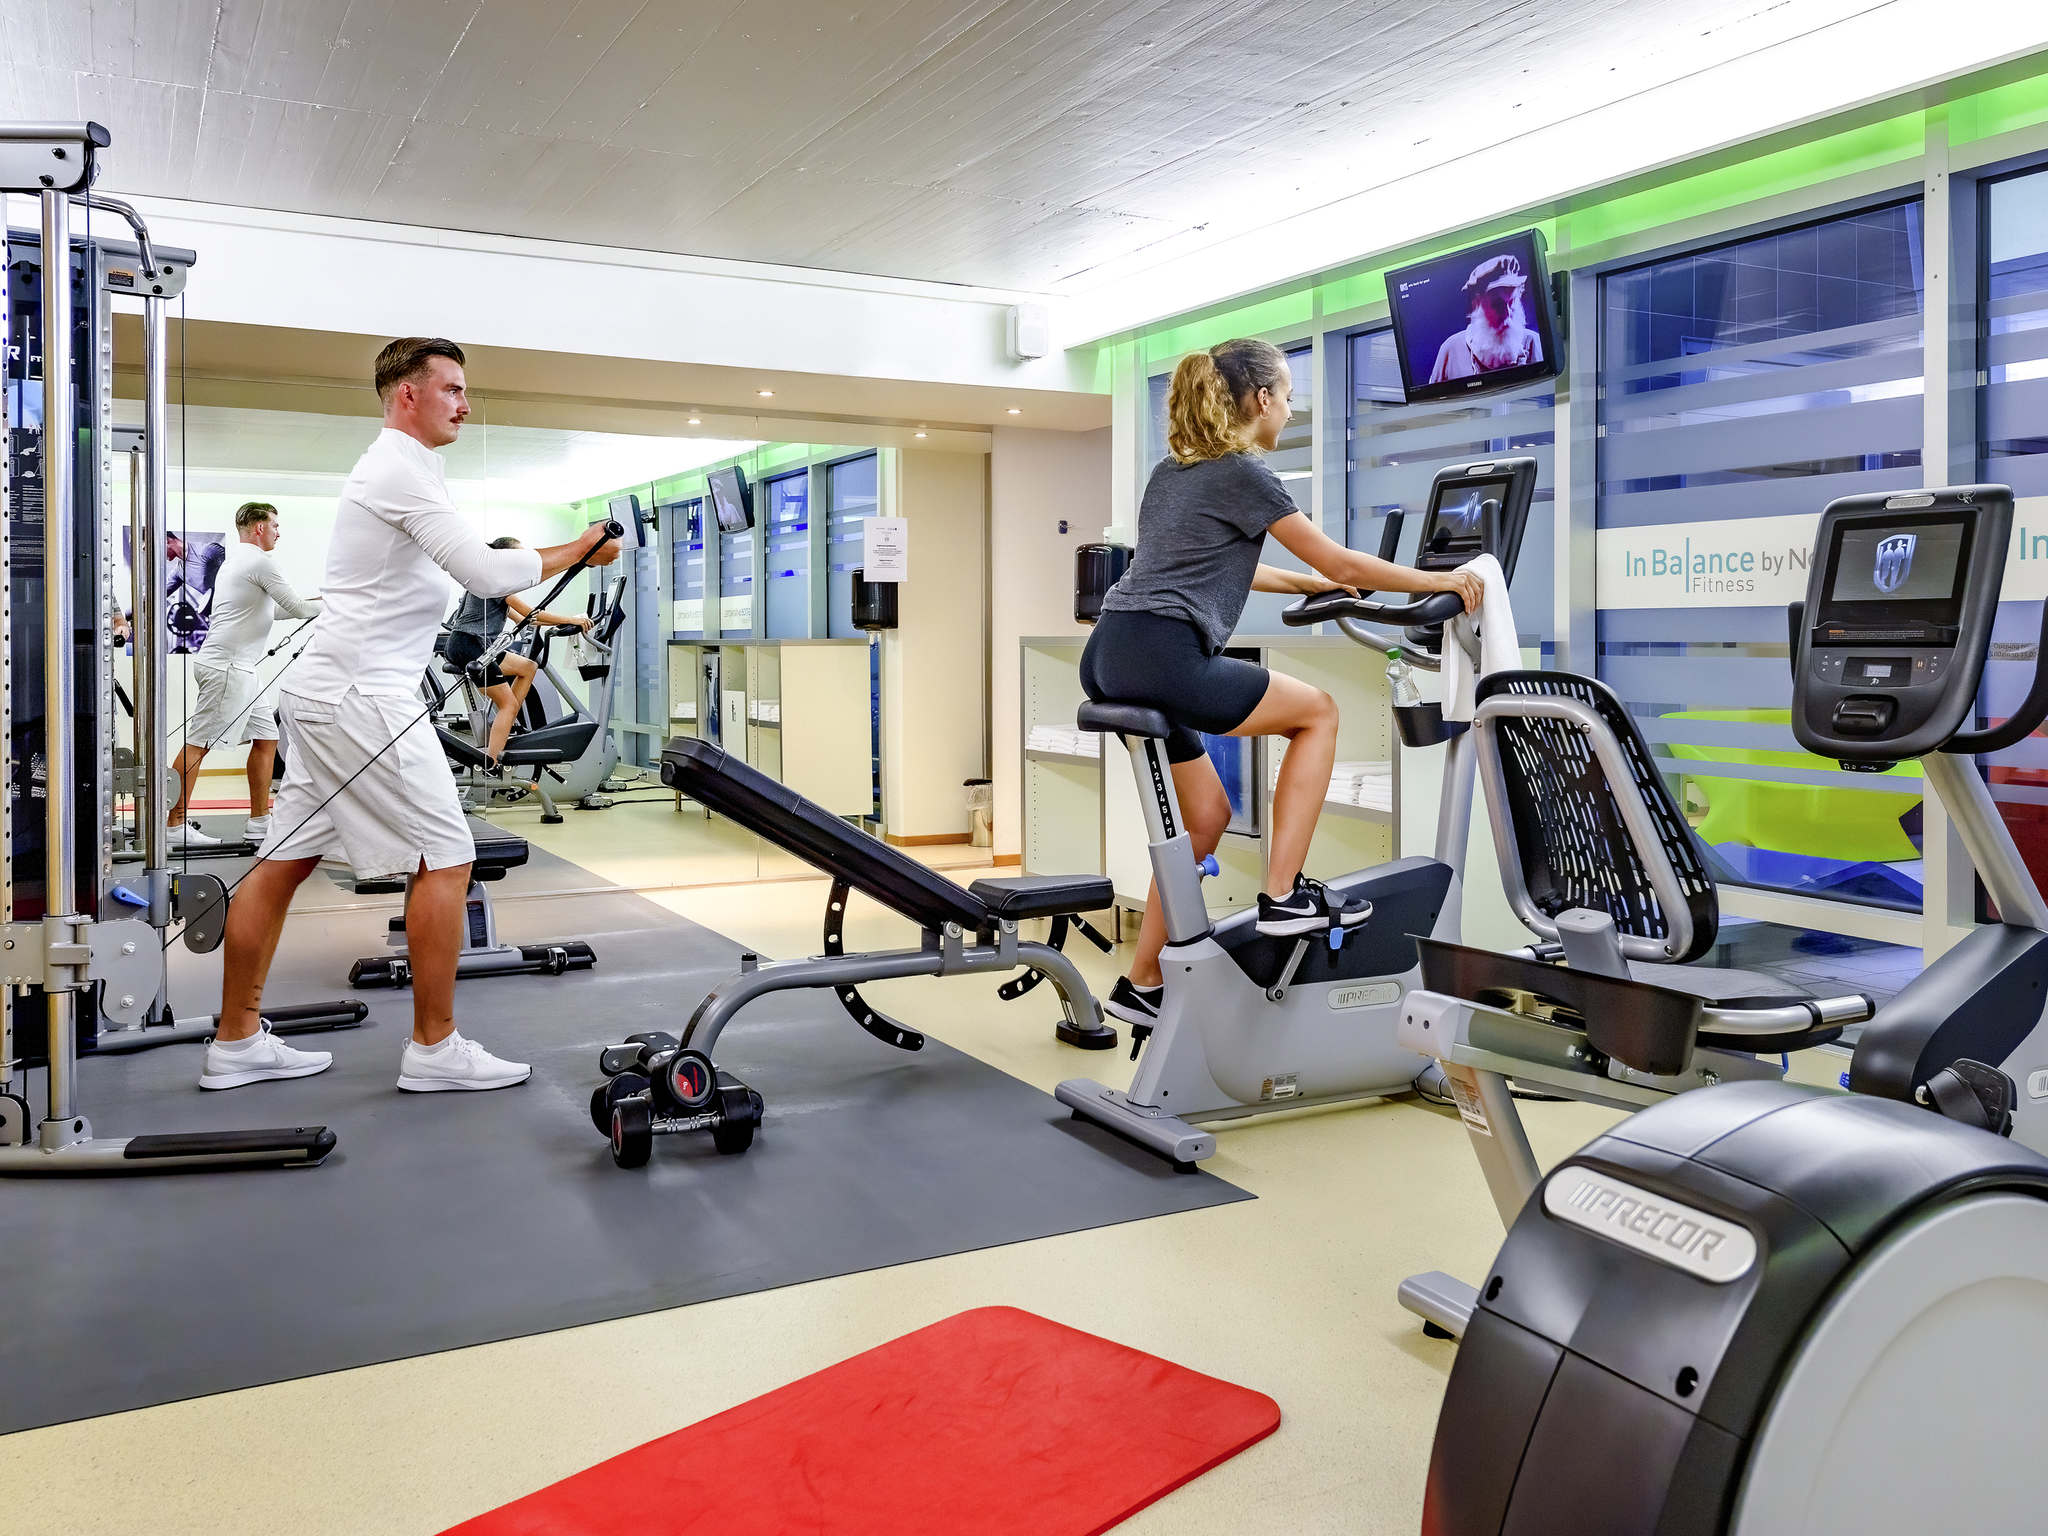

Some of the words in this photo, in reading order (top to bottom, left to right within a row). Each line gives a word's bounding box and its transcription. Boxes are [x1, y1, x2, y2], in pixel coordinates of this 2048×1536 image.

[1762, 551, 1784, 576] by
[1693, 577, 1755, 593] Fitness
[1583, 1186, 1727, 1261] PRECOR
